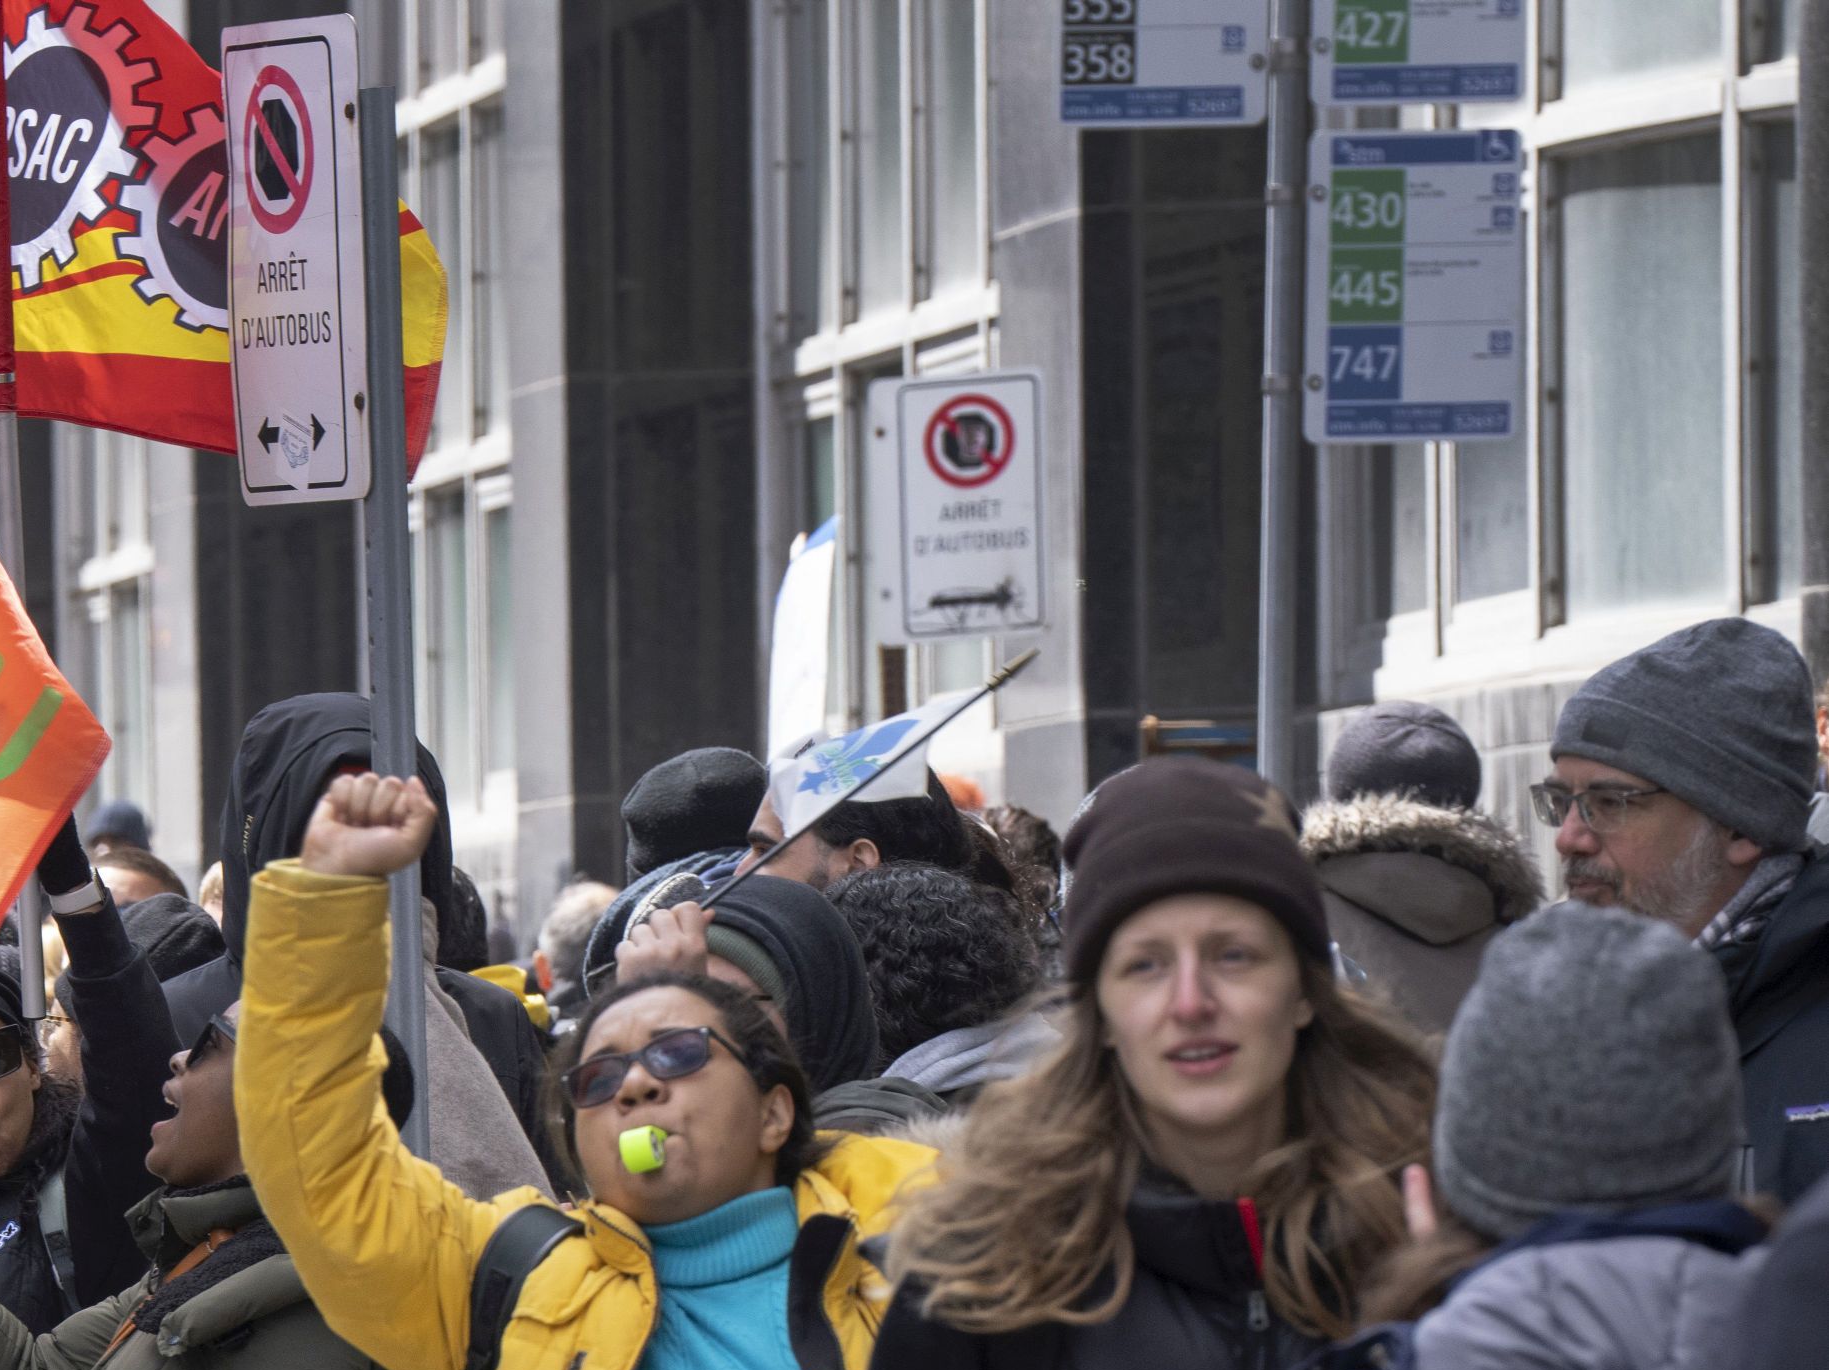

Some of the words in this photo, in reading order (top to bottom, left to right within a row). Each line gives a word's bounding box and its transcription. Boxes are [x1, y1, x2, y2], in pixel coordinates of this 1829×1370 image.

[1336, 10, 1406, 48] 427
[1064, 43, 1132, 81] 358
[1331, 191, 1404, 229] 430
[256, 250, 308, 294] ARRÊT
[1330, 269, 1401, 308] 445
[241, 310, 332, 350] D'AUTOBUS
[1330, 344, 1397, 382] 747
[937, 496, 1001, 523] ARRÊT
[913, 526, 1030, 556] D'AUTOBUS
